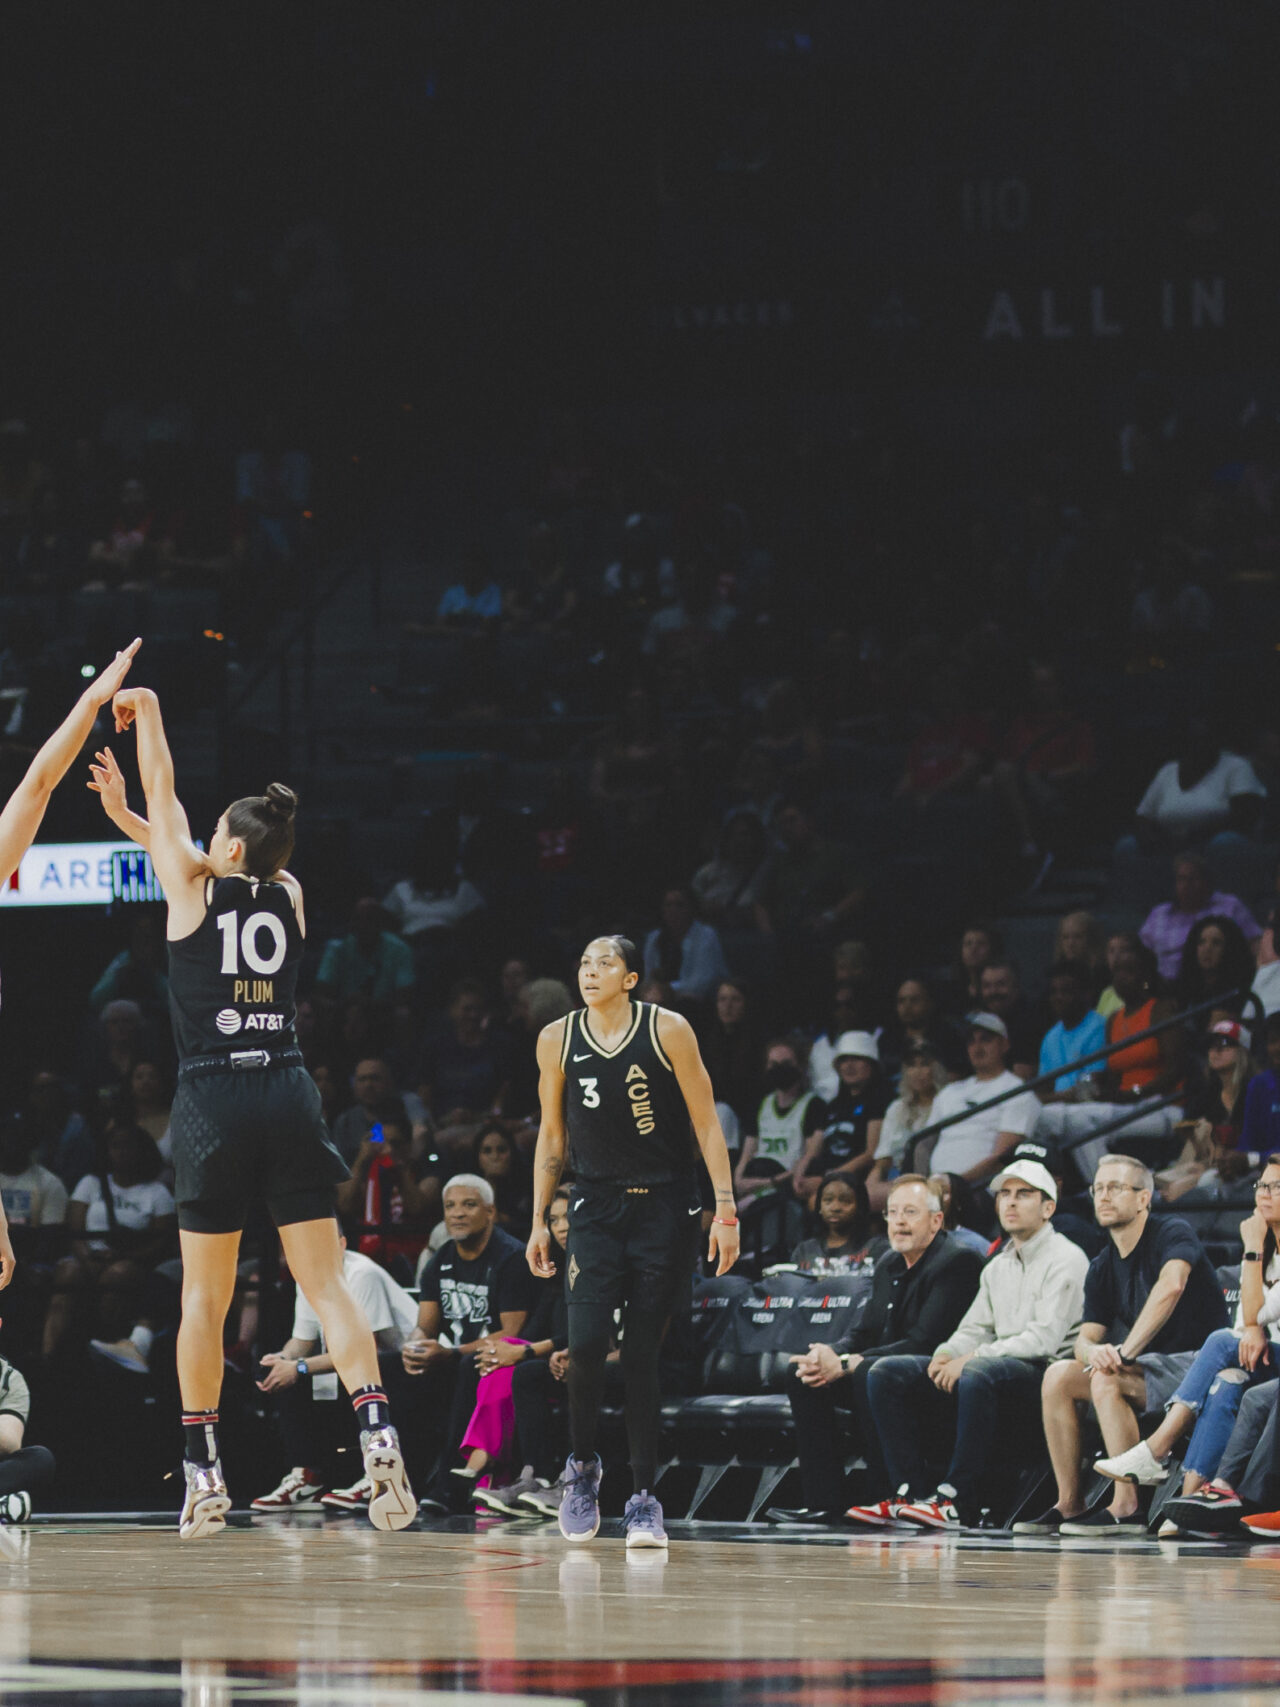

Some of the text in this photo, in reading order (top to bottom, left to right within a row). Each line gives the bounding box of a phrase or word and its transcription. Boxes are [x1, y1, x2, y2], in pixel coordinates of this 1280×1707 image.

[982, 277, 1225, 340] ALL IN
[217, 910, 287, 974] 10
[234, 980, 274, 1003] PLUM
[245, 1014, 284, 1030] AT&T
[578, 1078, 601, 1108] 3
[625, 1064, 655, 1135] ACES
